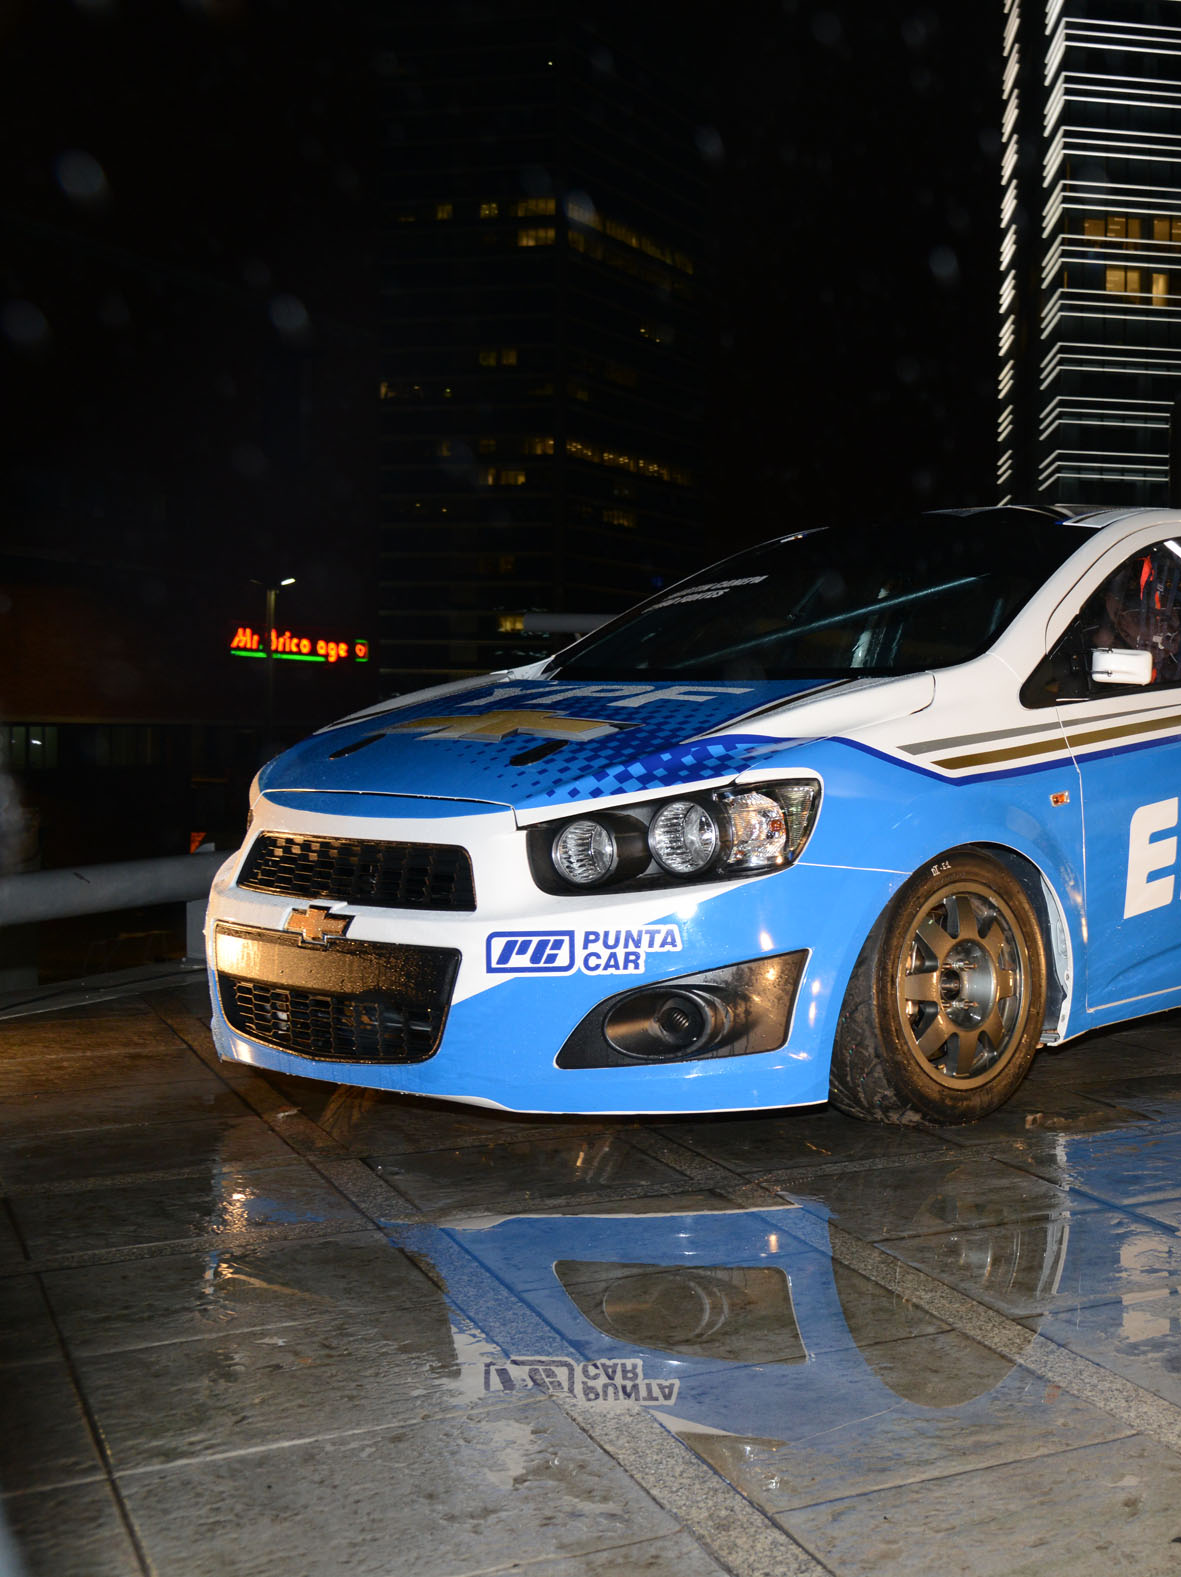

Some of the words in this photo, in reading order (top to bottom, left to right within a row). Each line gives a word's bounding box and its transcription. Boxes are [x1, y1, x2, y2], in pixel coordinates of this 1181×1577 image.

[456, 684, 755, 707] YPF
[582, 929, 678, 950] PUNTA
[582, 951, 641, 971] CAR
